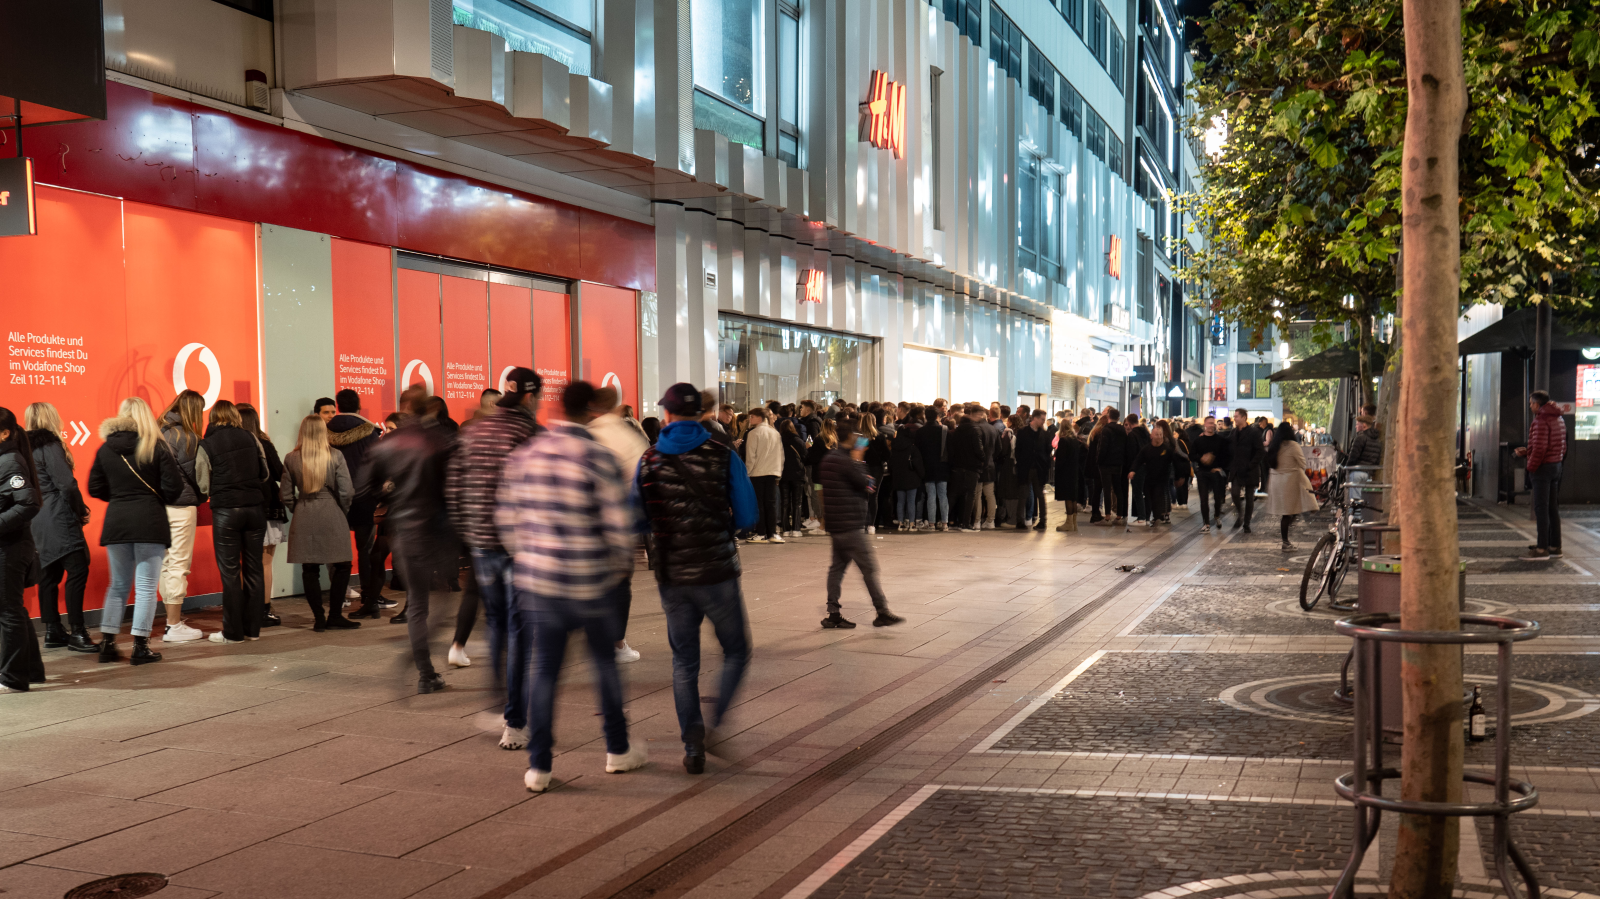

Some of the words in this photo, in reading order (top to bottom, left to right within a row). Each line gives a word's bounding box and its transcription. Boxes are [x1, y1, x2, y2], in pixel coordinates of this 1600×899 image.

[869, 69, 906, 160] H&M
[805, 269, 824, 304] H&M
[8, 331, 25, 342] Alle
[27, 332, 66, 345] Produkte
[67, 336, 83, 346] und
[8, 345, 46, 358] Services
[46, 348, 75, 359] findest
[77, 349, 88, 360] Du
[339, 354, 350, 362] Alle
[350, 354, 374, 364] Produkte
[374, 356, 384, 364] und
[9, 360, 20, 370] im
[22, 360, 63, 372] Vodafone
[64, 362, 86, 375] Shop
[340, 364, 362, 374] Services
[362, 366, 379, 374] findest
[380, 366, 387, 375] Du
[456, 362, 474, 370] Produkte
[474, 364, 482, 372] und
[10, 374, 26, 384] Zeil
[28, 374, 66, 386] 112–114
[340, 375, 348, 384] im
[348, 376, 372, 384] Vodafone
[372, 376, 386, 386] Shop
[446, 372, 464, 380] Services
[464, 372, 478, 380] findest
[453, 382, 472, 390] Vodafone
[473, 382, 484, 391] Shop
[447, 390, 456, 398] Zeil
